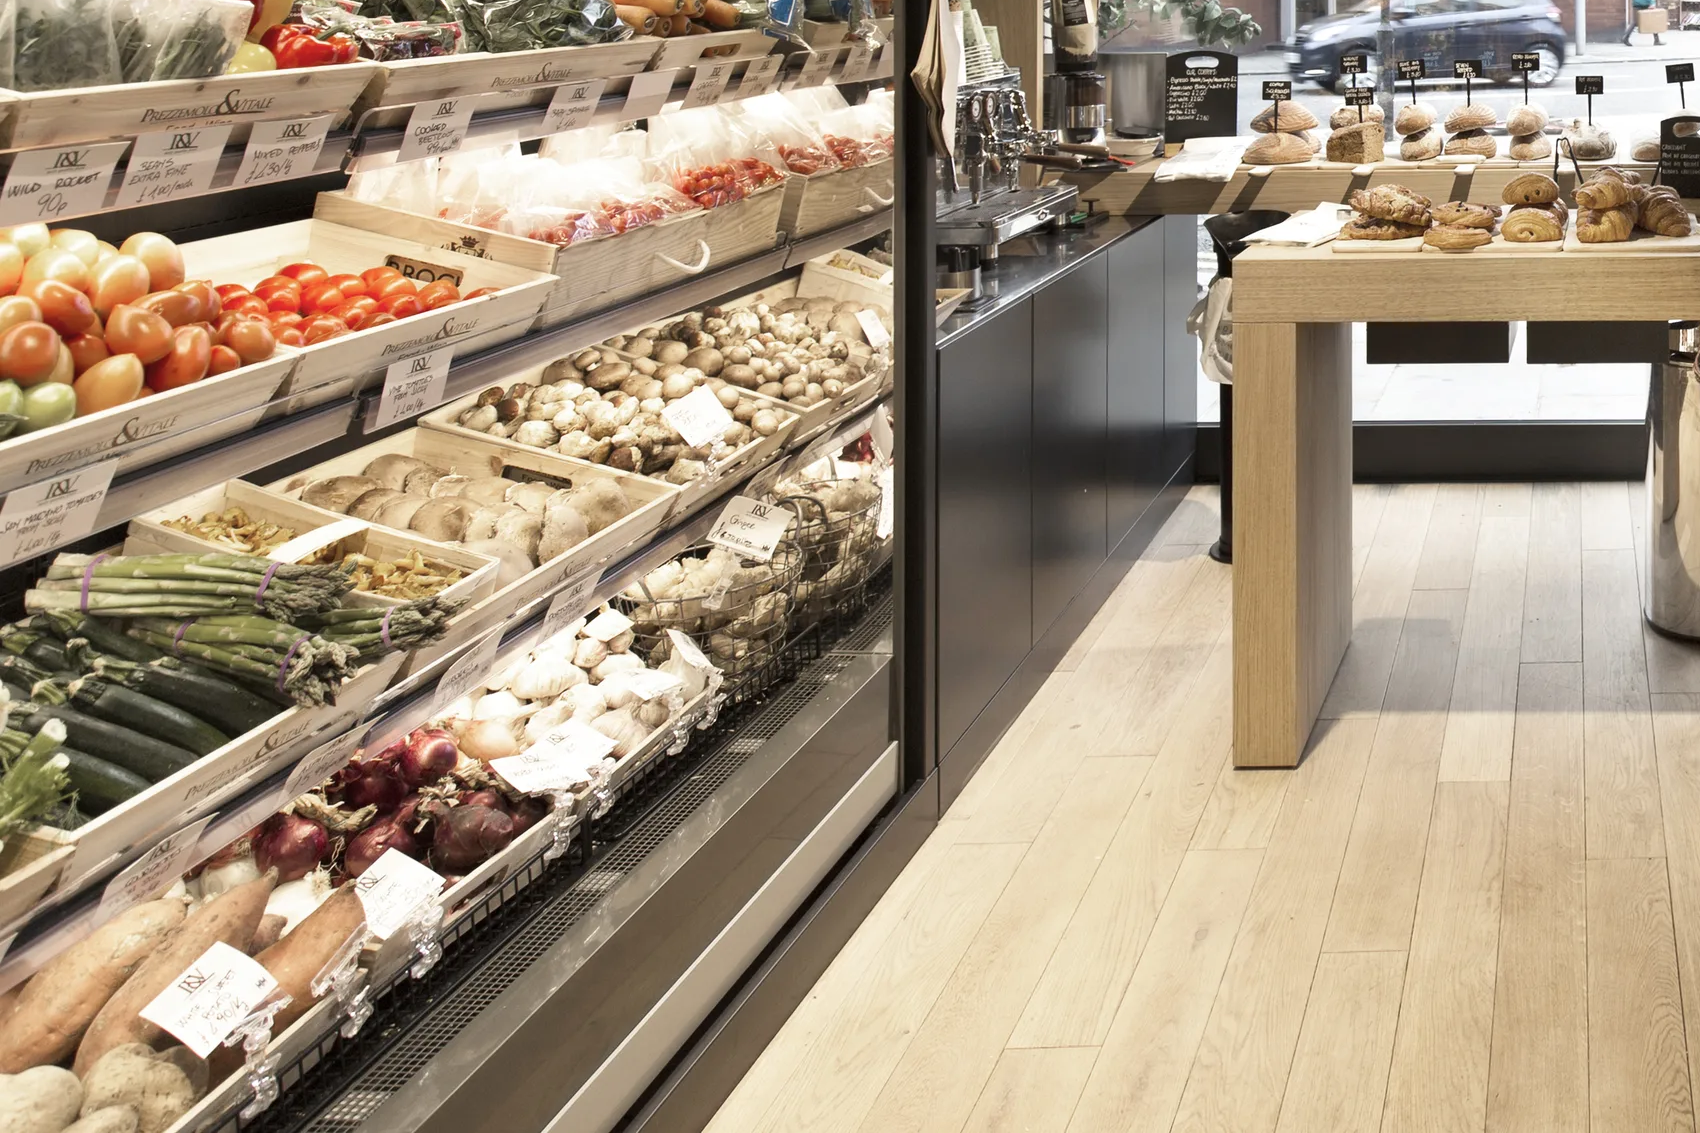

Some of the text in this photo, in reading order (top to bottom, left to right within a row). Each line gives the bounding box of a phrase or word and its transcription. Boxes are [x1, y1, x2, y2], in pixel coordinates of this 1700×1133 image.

[8, 172, 101, 199] WILD ROCKET
[37, 193, 68, 217] 90p
